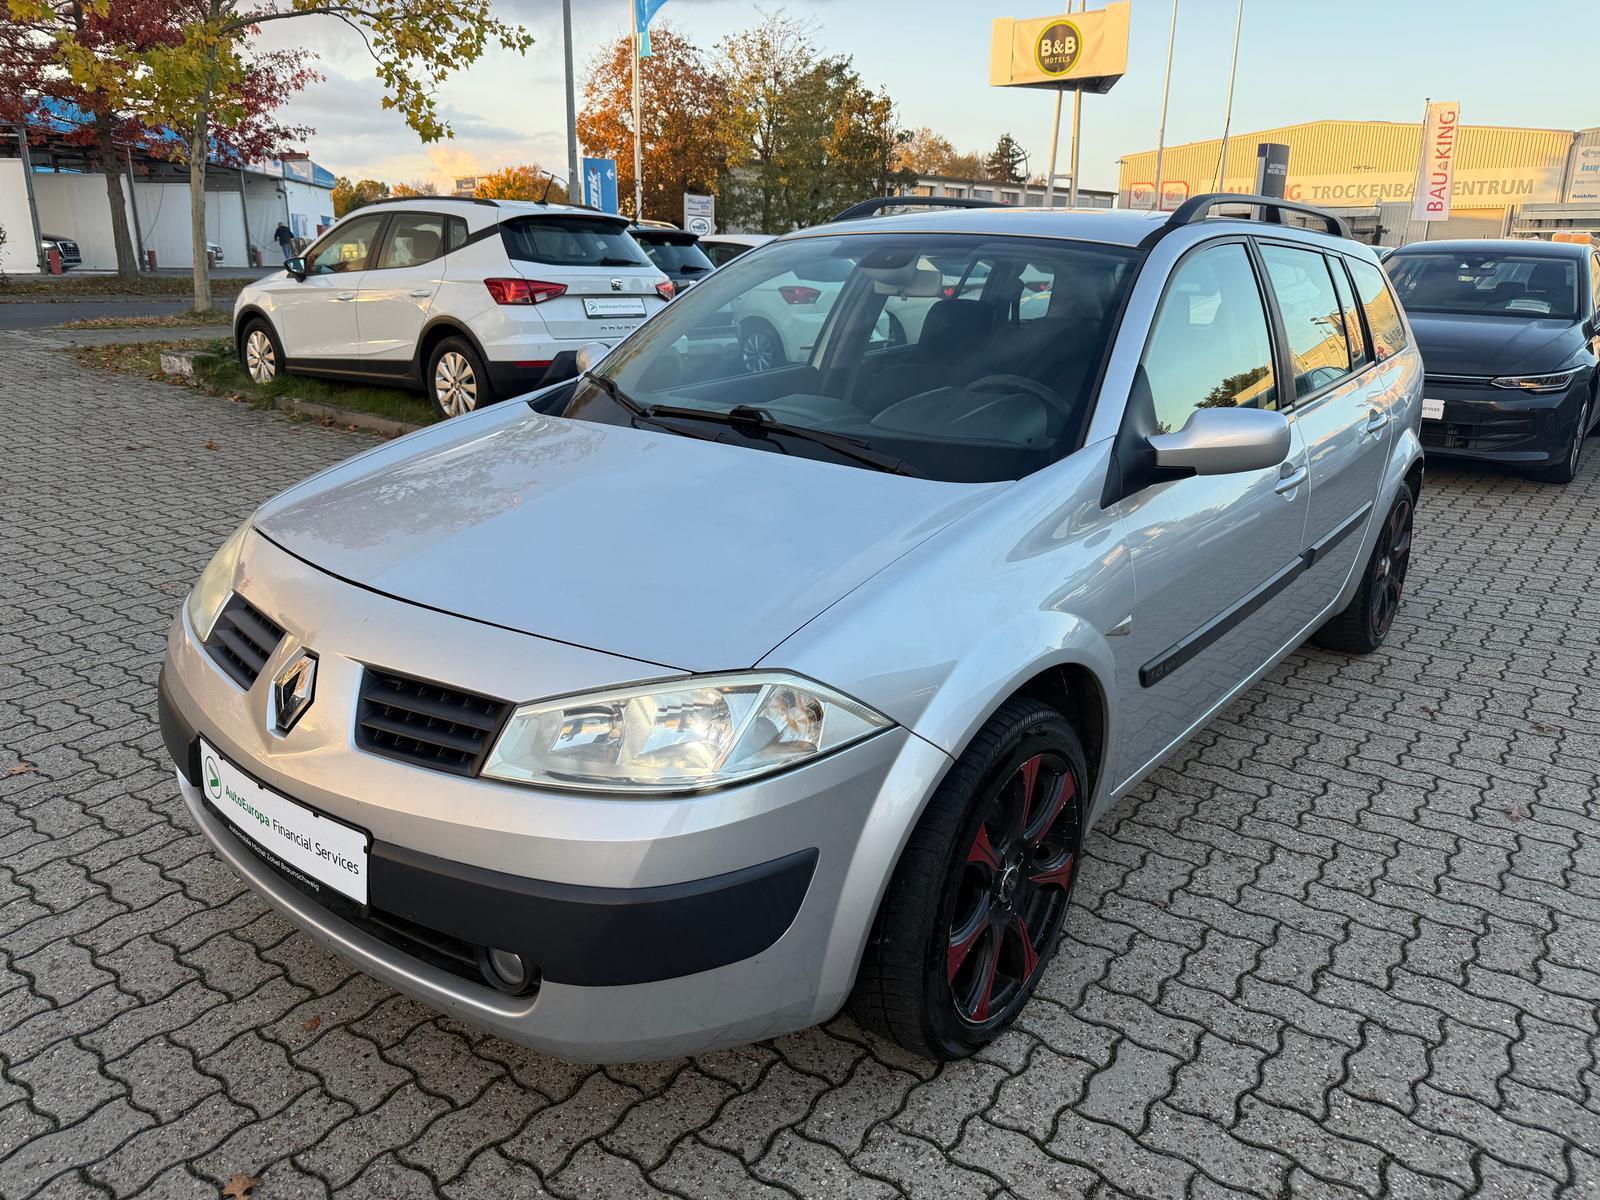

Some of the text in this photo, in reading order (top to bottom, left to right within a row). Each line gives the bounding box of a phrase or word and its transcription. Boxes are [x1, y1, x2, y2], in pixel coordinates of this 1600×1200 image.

[1041, 37, 1076, 57] B&B
[1044, 55, 1071, 64] HOTELS
[1426, 111, 1456, 212] BAU KING
[1311, 183, 1414, 199] TROCKENBA
[1452, 179, 1534, 196] ENTRUM
[225, 785, 360, 876] AutoEuropa Financial Services
[280, 862, 320, 893] Braunschweig
